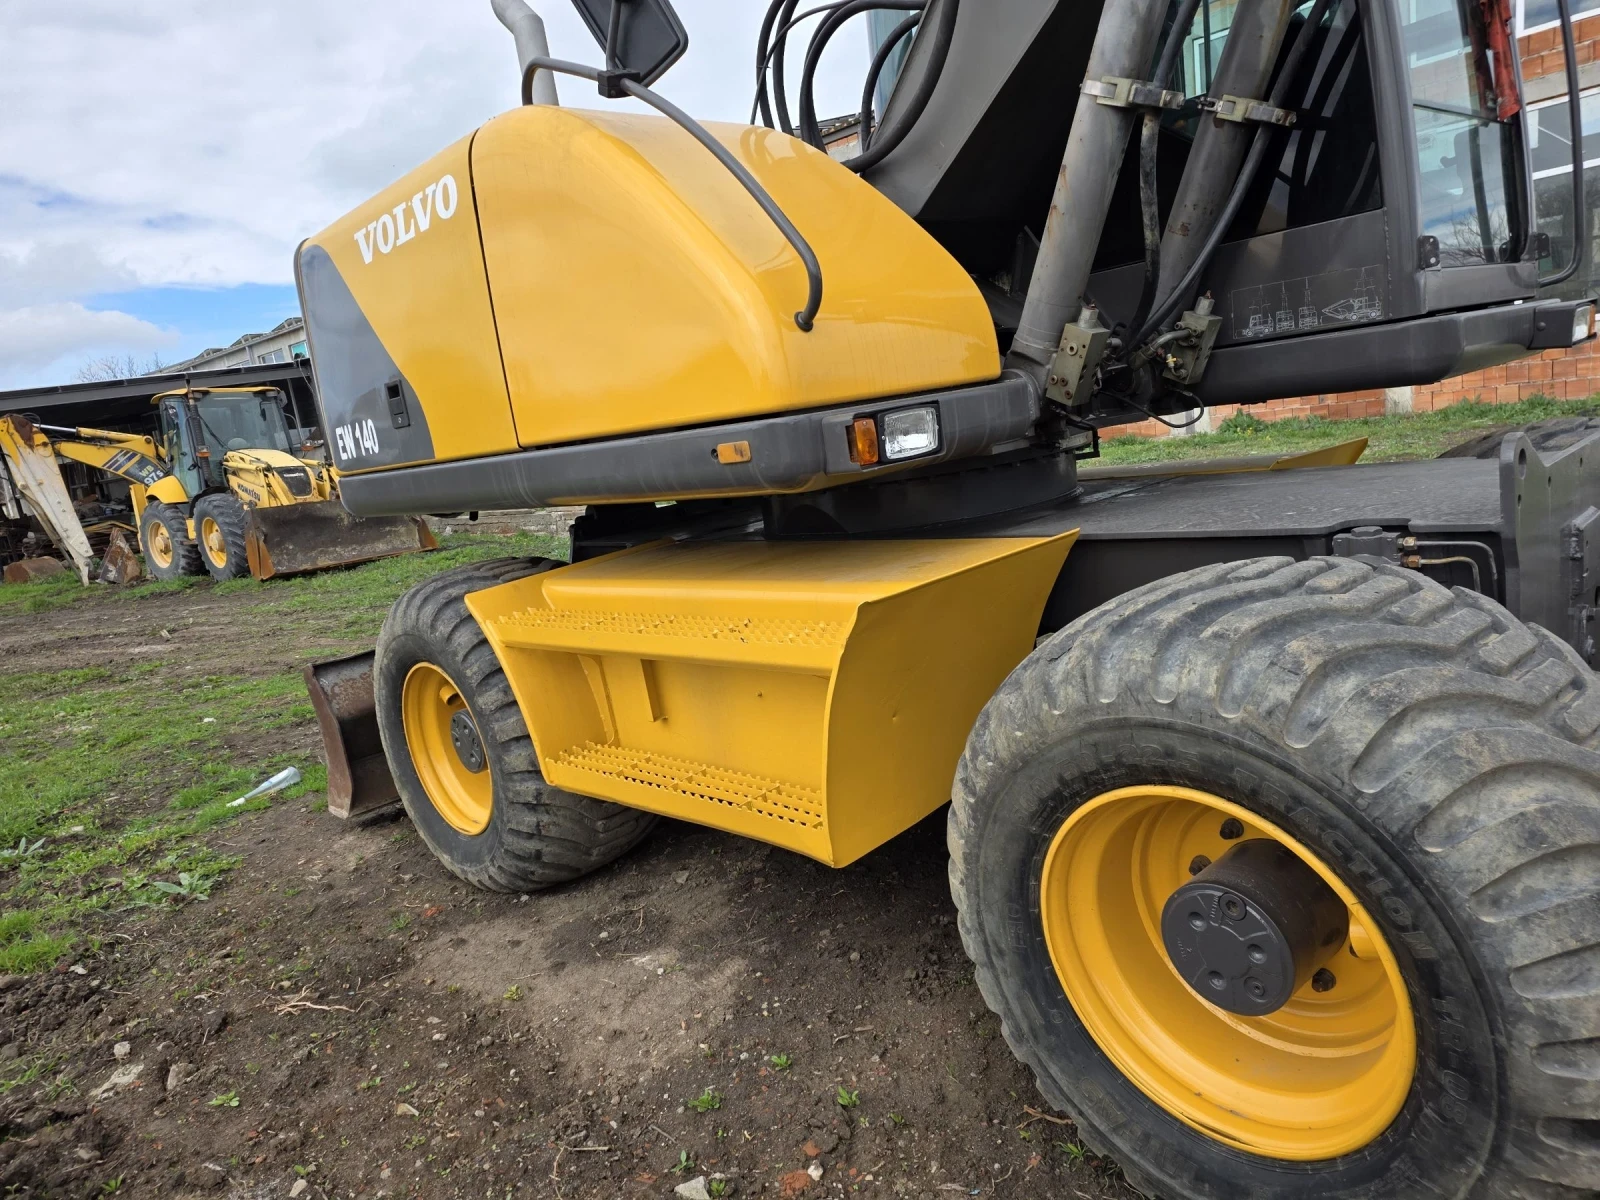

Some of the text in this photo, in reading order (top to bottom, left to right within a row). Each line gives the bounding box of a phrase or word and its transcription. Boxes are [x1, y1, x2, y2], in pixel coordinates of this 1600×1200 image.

[353, 174, 458, 265] VOLVO
[139, 465, 155, 477] WB
[335, 418, 379, 461] EW 140
[1234, 767, 1440, 960] TRACTION
